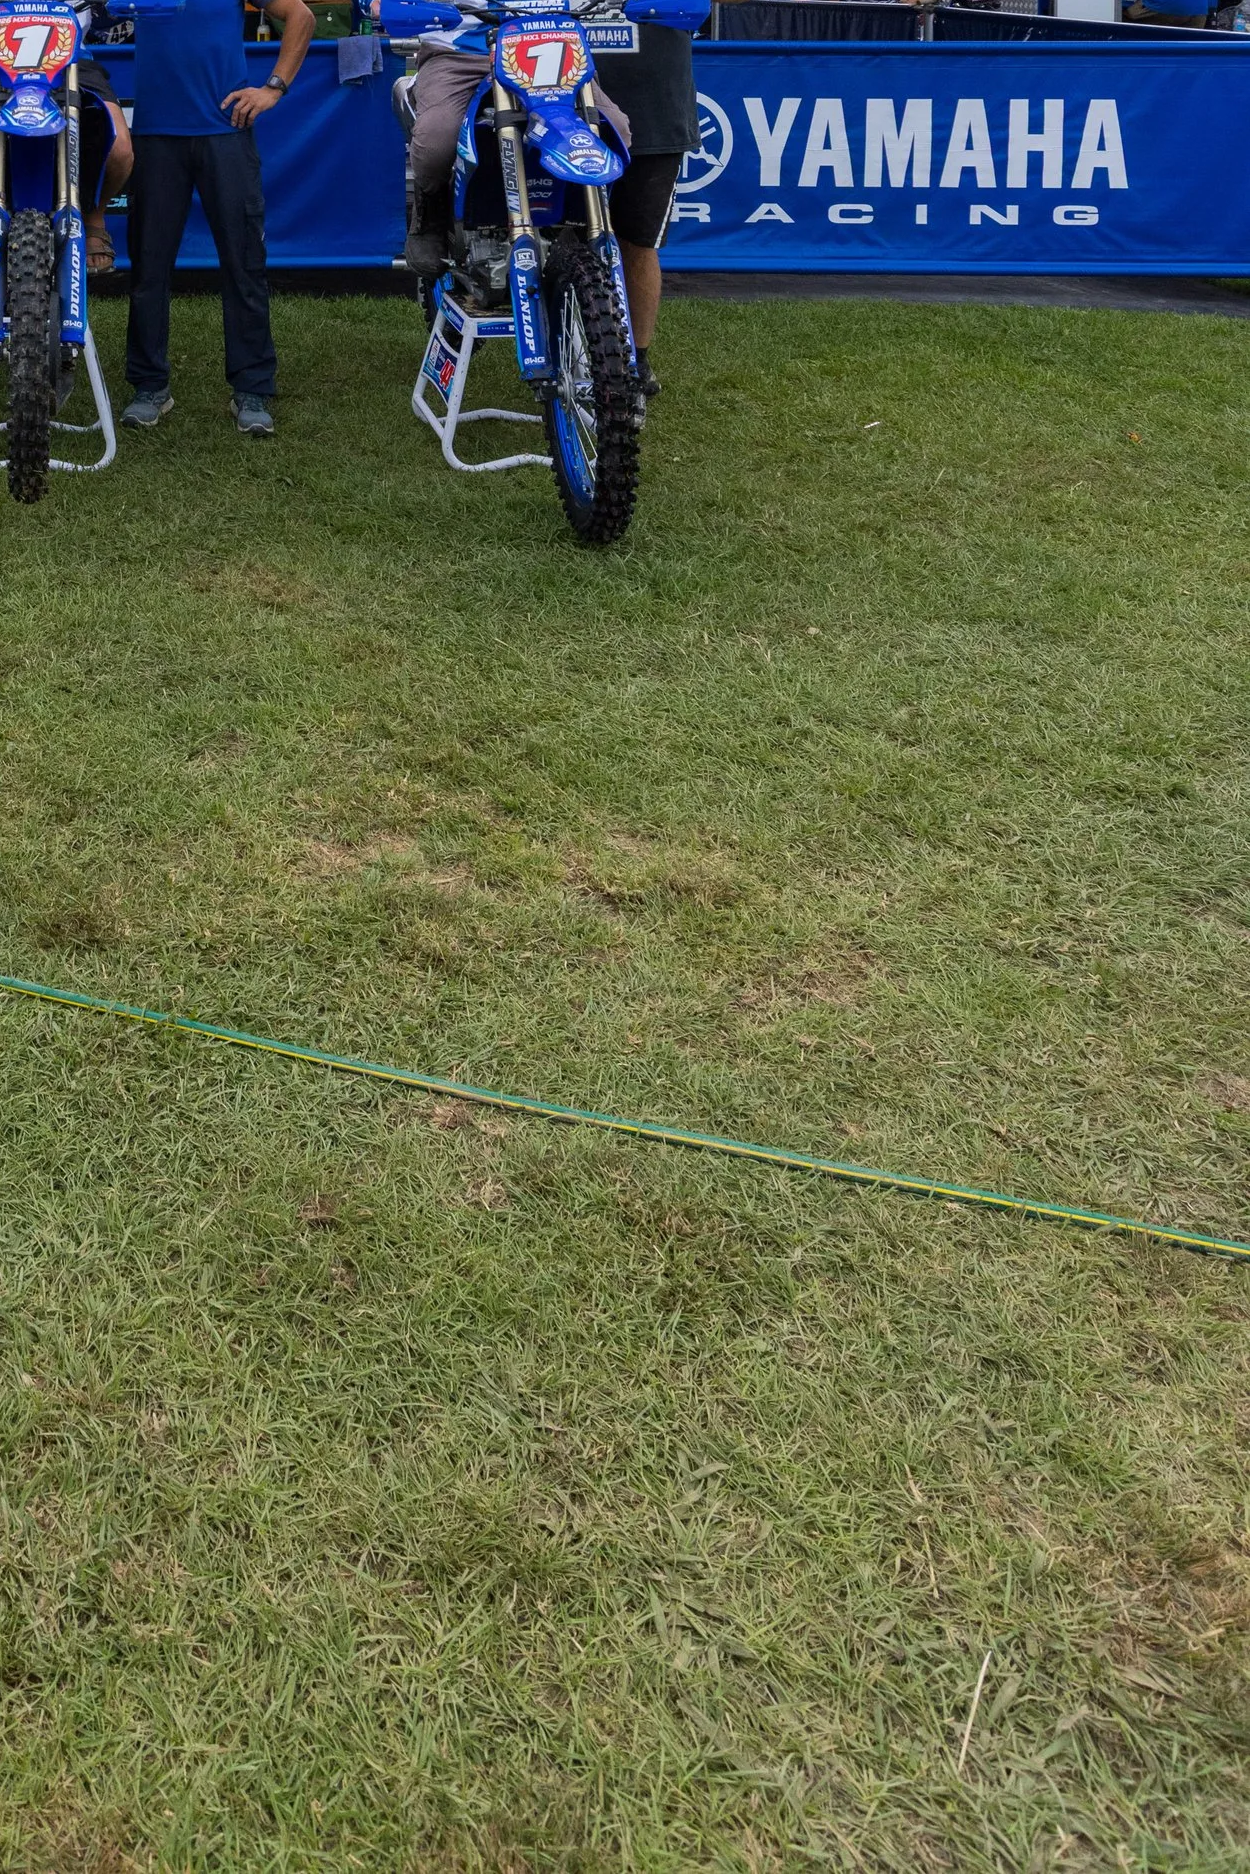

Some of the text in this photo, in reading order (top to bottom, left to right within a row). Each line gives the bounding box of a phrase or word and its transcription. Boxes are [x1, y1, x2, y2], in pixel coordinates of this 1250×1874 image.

[12, 16, 30, 24] MX2
[31, 16, 72, 25] CHAMPION
[13, 4, 49, 13] YAMAHA
[521, 20, 576, 31] YAMAHA JCR
[12, 24, 54, 69] 1
[501, 32, 580, 45] 2026 MX1 CHAMPION
[526, 41, 566, 87] 1
[742, 97, 1129, 189] YAMAHA
[669, 201, 1100, 226] RACING
[518, 252, 531, 260] KT
[70, 243, 81, 318] DUNLOP
[517, 274, 536, 355] DUNLOP
